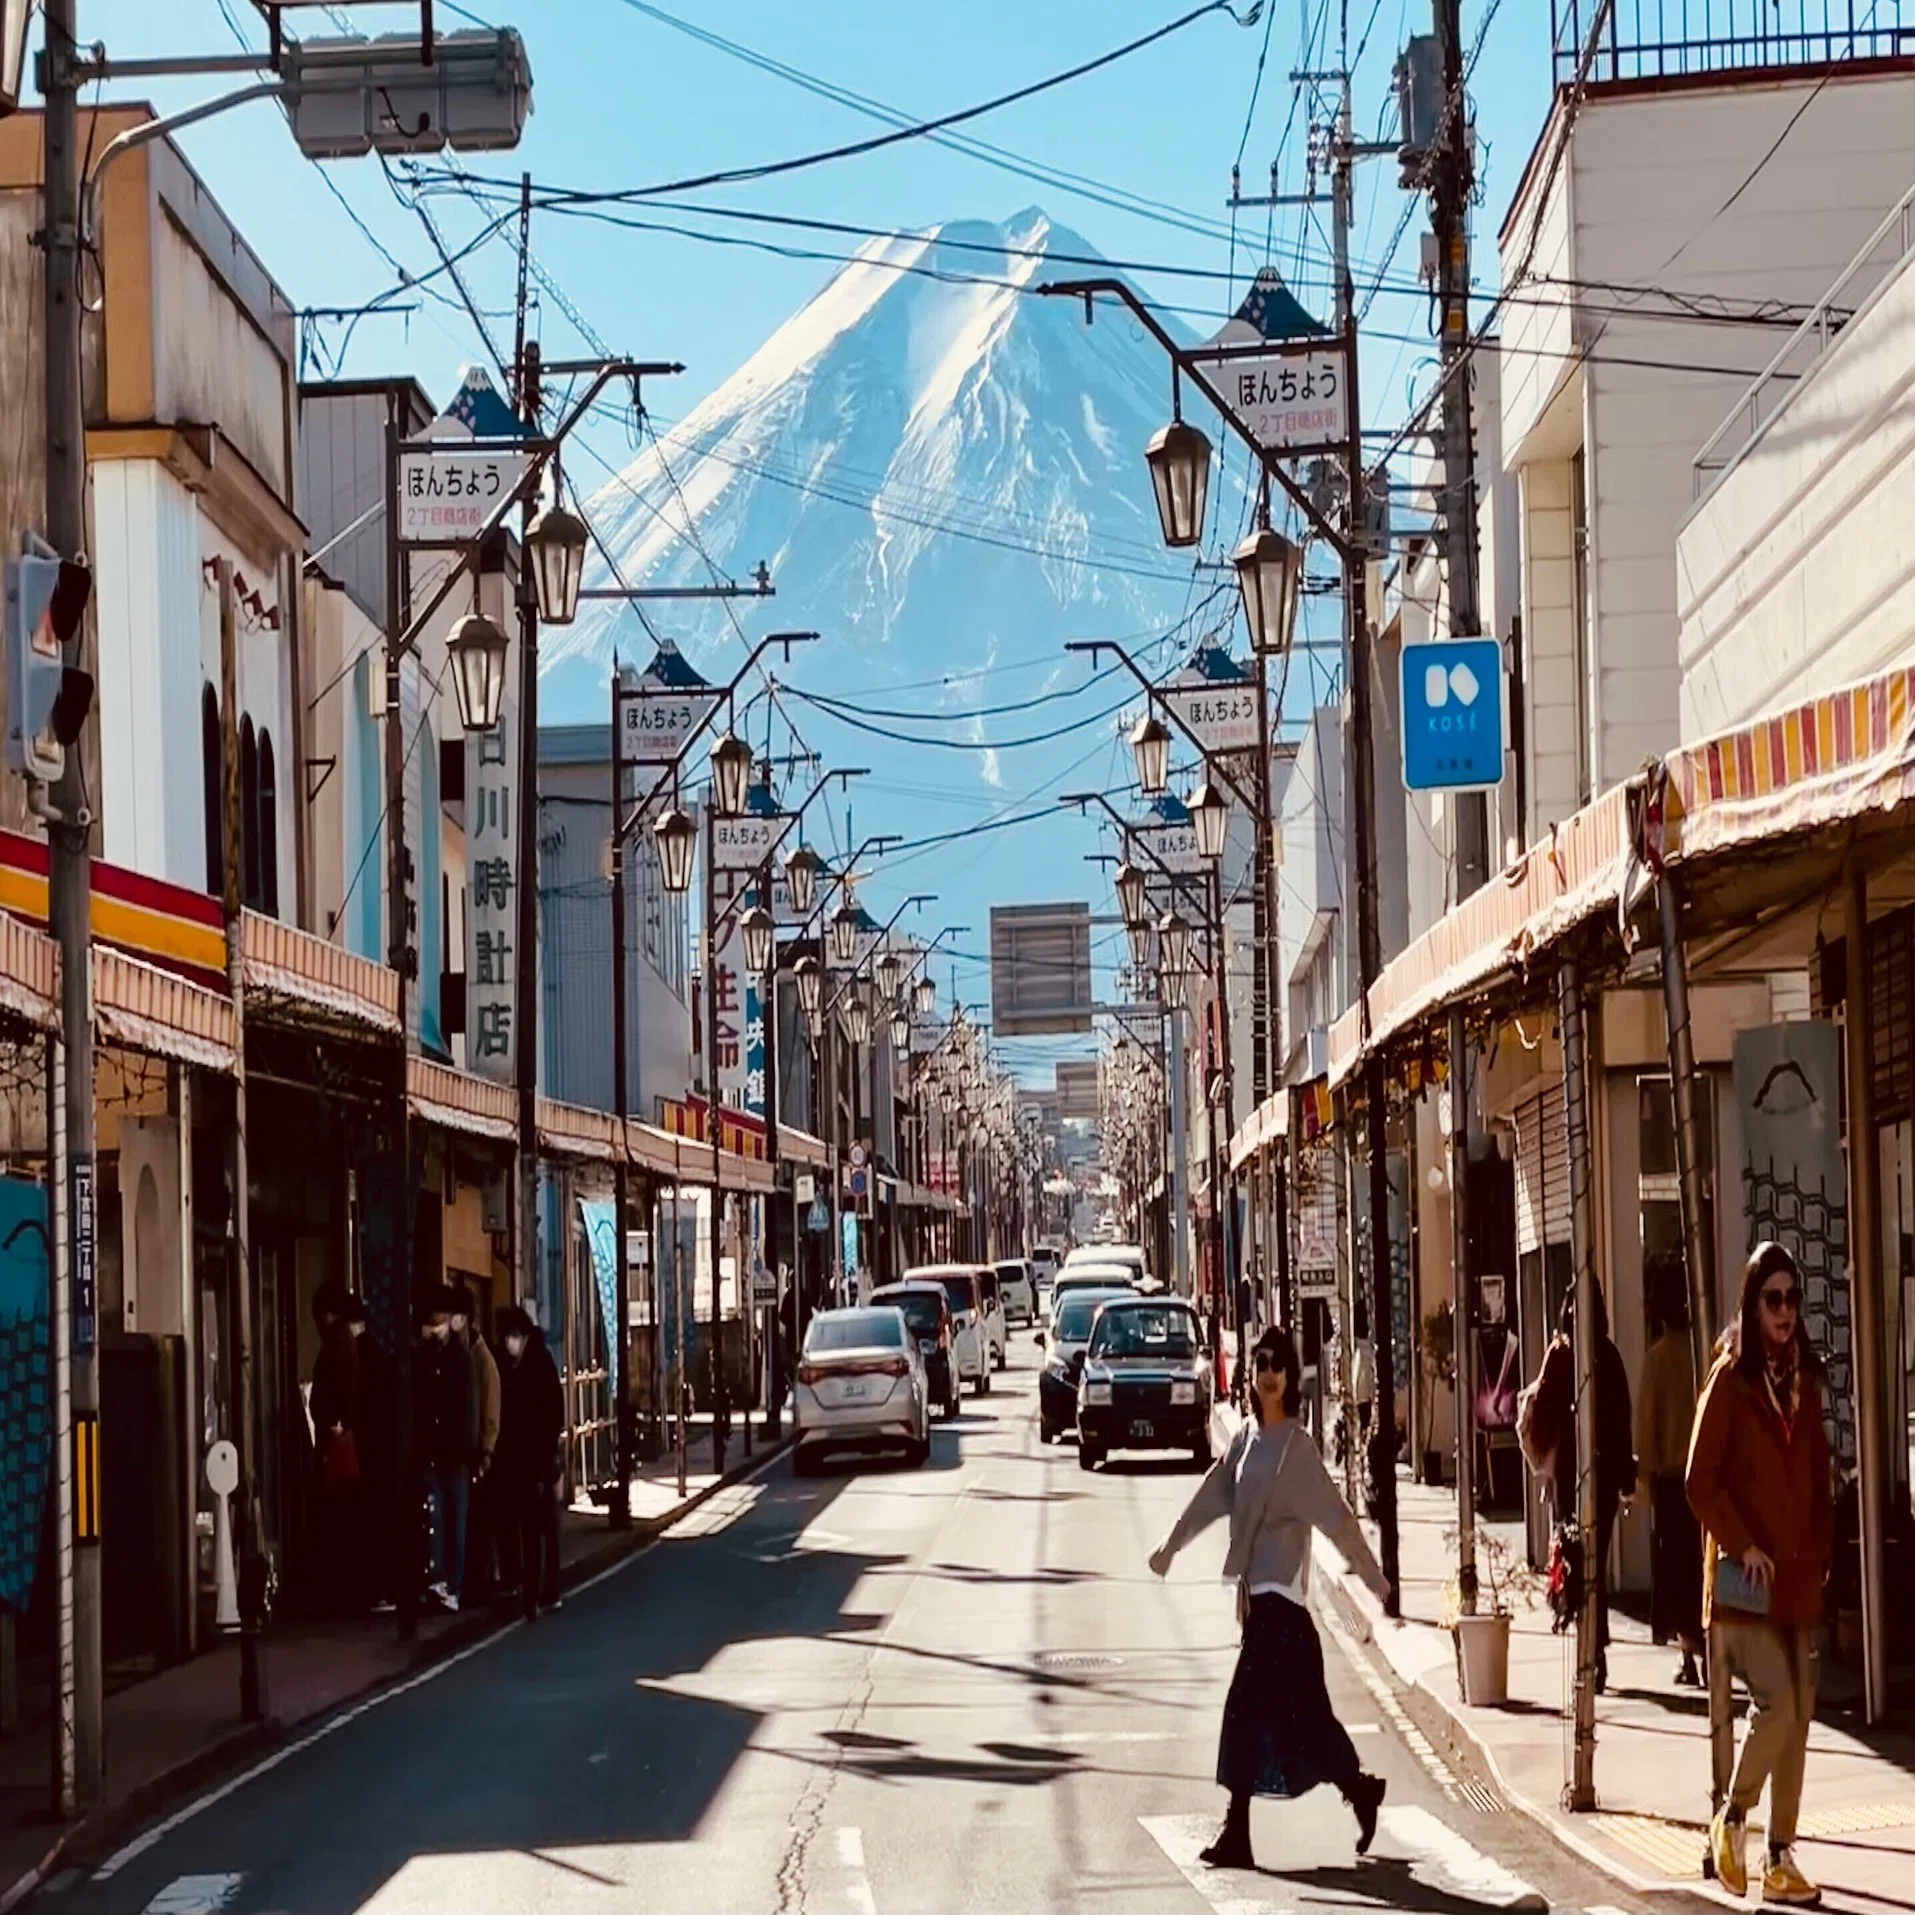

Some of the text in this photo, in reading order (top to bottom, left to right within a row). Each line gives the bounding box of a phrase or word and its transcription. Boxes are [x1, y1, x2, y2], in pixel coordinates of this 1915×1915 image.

[1239, 363, 1337, 406] ほんちょう
[407, 463, 500, 497] ほんちょう
[627, 706, 692, 730] ほんちょう
[1190, 697, 1254, 723] ほんちょう
[718, 827, 770, 845] ほんちょう
[1157, 836, 1197, 854] ほんちょ
[474, 712, 514, 1058] 日川時計店
